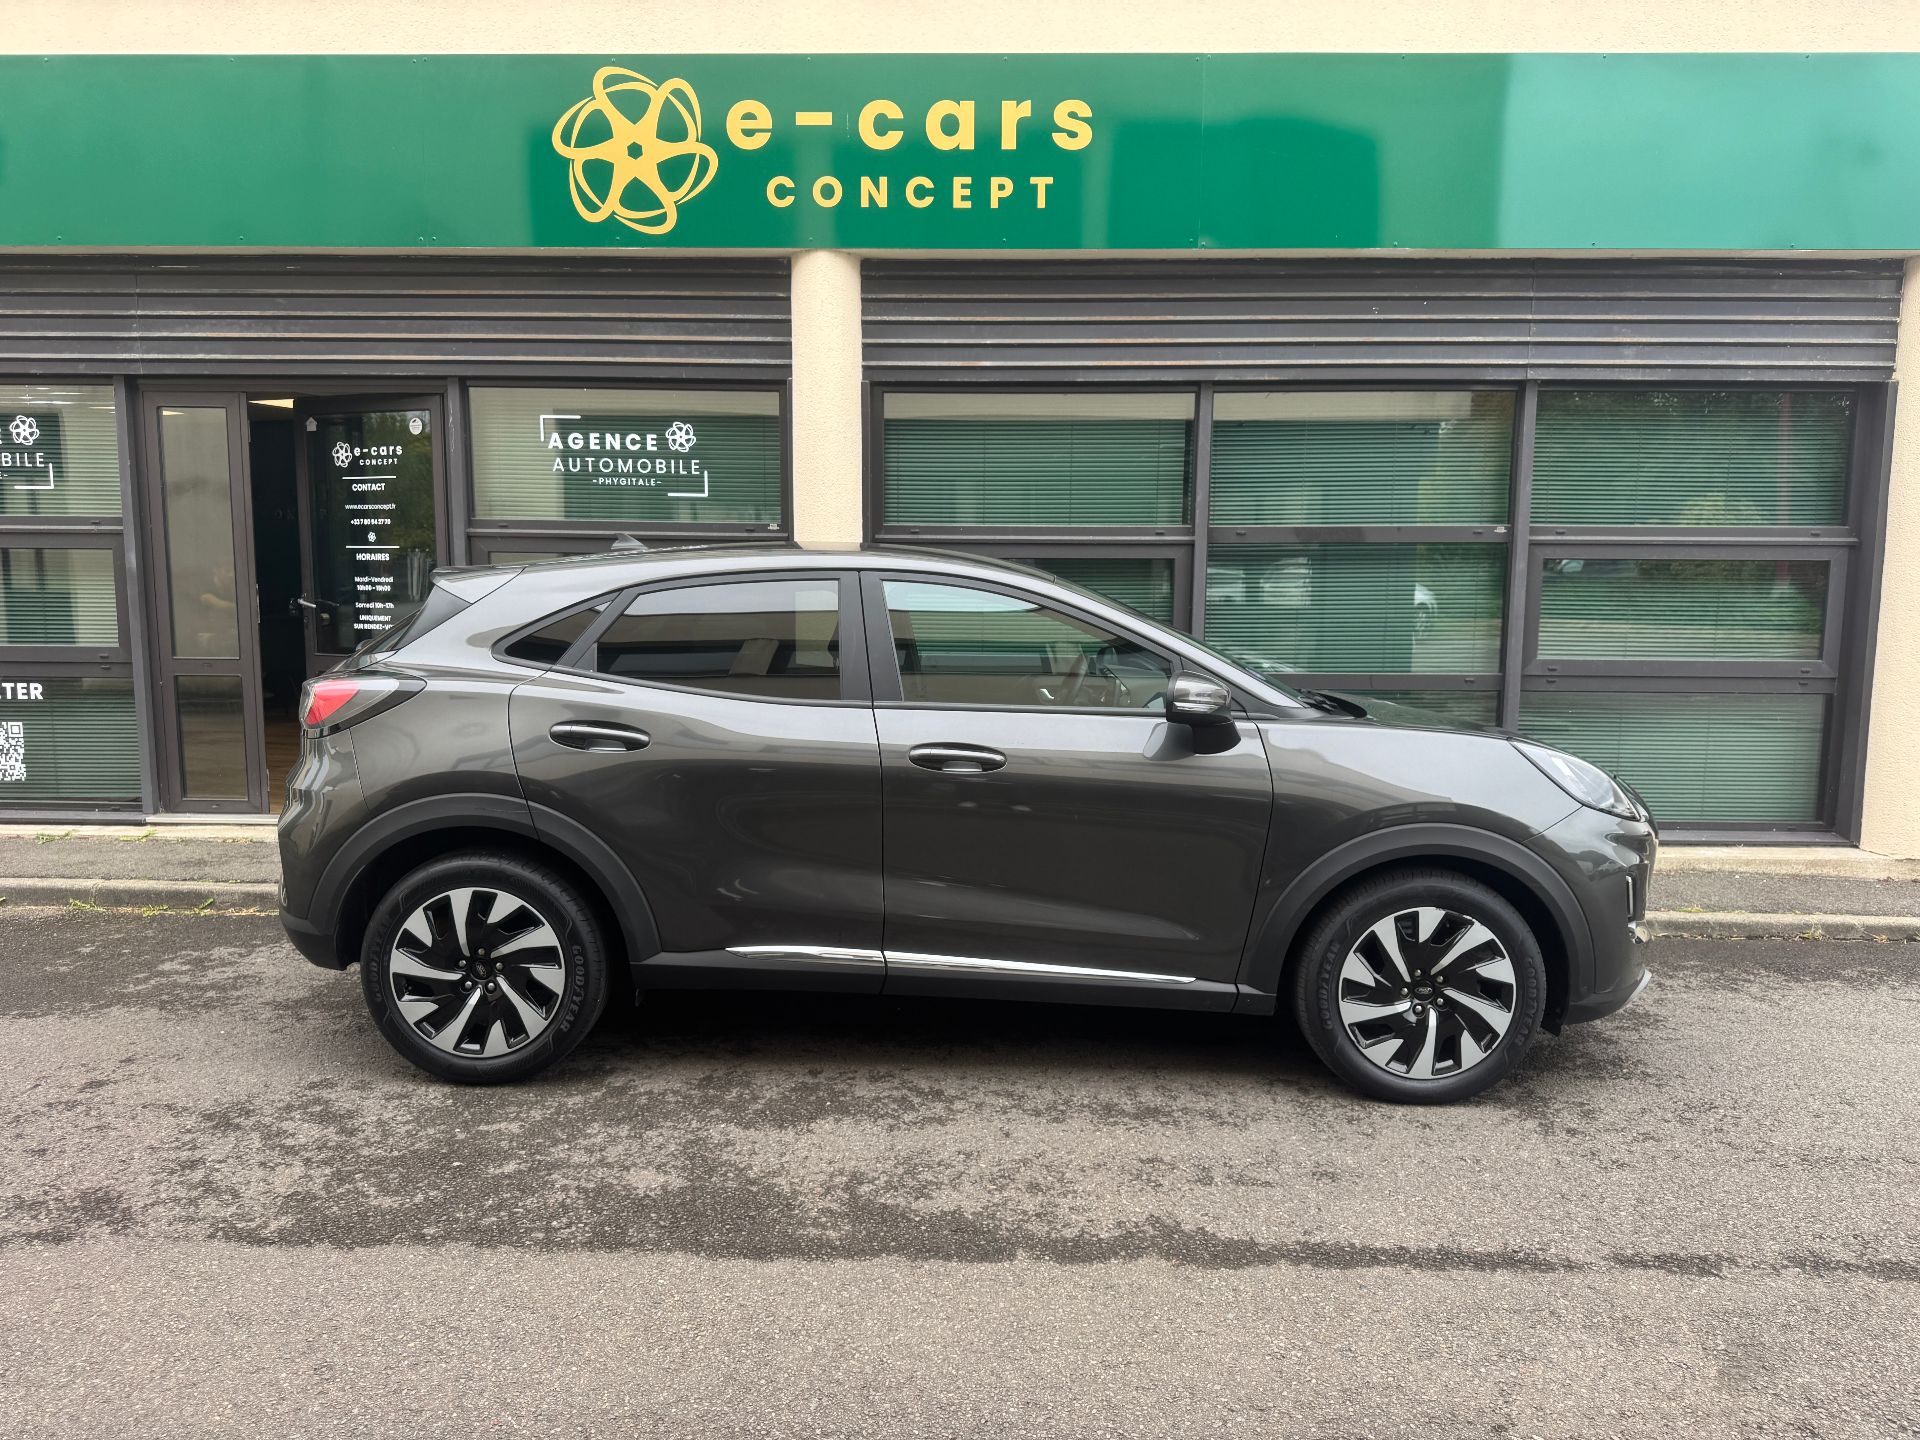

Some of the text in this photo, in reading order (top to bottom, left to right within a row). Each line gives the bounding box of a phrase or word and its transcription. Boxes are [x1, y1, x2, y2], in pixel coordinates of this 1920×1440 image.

[726, 99, 1093, 150] e-cars
[766, 175, 1054, 209] CONCEPT
[548, 432, 658, 451] AGENCE
[353, 445, 403, 456] e-cars
[359, 458, 398, 466] CONCEPT
[552, 457, 700, 475] AUTOMOBILE
[351, 482, 386, 491] CONTACT
[355, 552, 390, 561] HORAIRES
[359, 614, 392, 622] UNIQUEMENT
[353, 622, 364, 630] SUR
[0, 682, 44, 700] TER
[560, 943, 585, 1033] GOODYEAR
